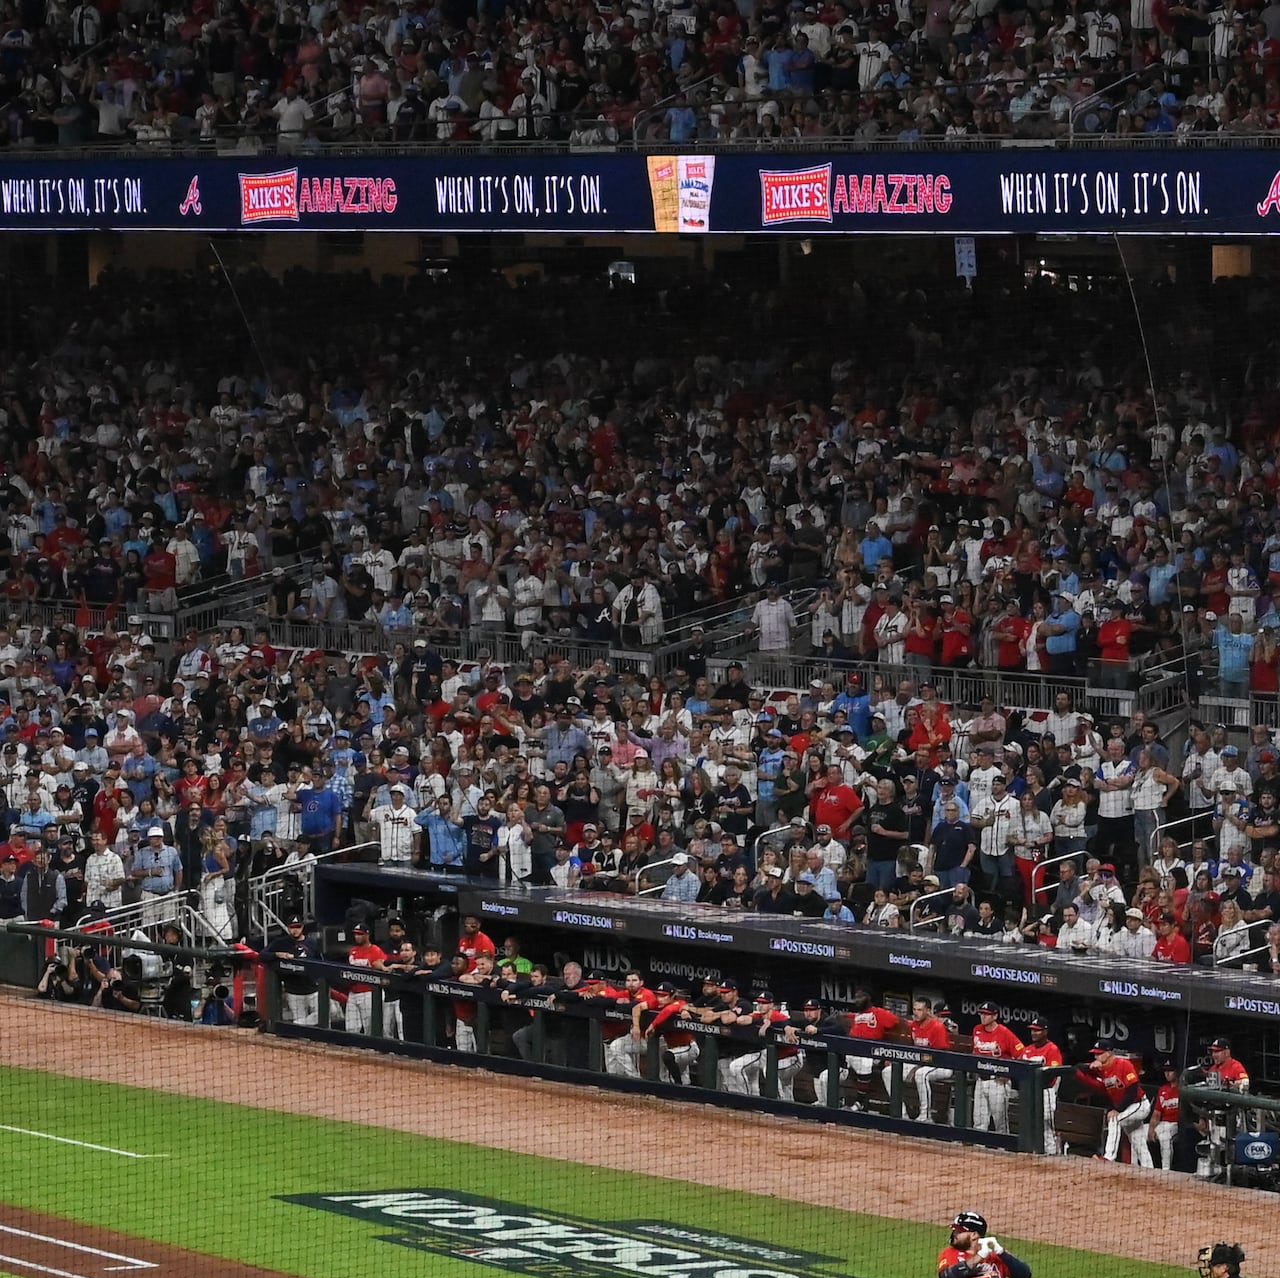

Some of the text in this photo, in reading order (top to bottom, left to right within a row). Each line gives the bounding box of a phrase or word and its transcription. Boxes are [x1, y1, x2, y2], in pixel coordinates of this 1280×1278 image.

[1, 178, 147, 217] WHEN IT'S ON, IT'S ON.
[248, 185, 293, 211] MIKE'S
[299, 177, 397, 213] AMAZING
[436, 174, 607, 217] WHEN IT'S ON, IT'S ON.
[771, 182, 824, 211] MIKE'S
[833, 174, 952, 214] AMAZING
[1000, 171, 1209, 219] WHEN IT'S ON, IT'S ON.
[482, 901, 519, 915] Booking.com
[562, 911, 612, 929] POSTSEASON
[672, 925, 734, 944] NLDS Booking.com
[781, 938, 835, 957] POSTSEASON
[583, 947, 632, 974] NLDS
[649, 956, 721, 983] Booking.com
[889, 953, 932, 969] Booking.com
[982, 964, 1041, 984] POSTSEASON
[1111, 981, 1182, 1001] NLDS Booking.com
[682, 1020, 721, 1036] POSTSEASON
[879, 1047, 921, 1061] POSTSEASON
